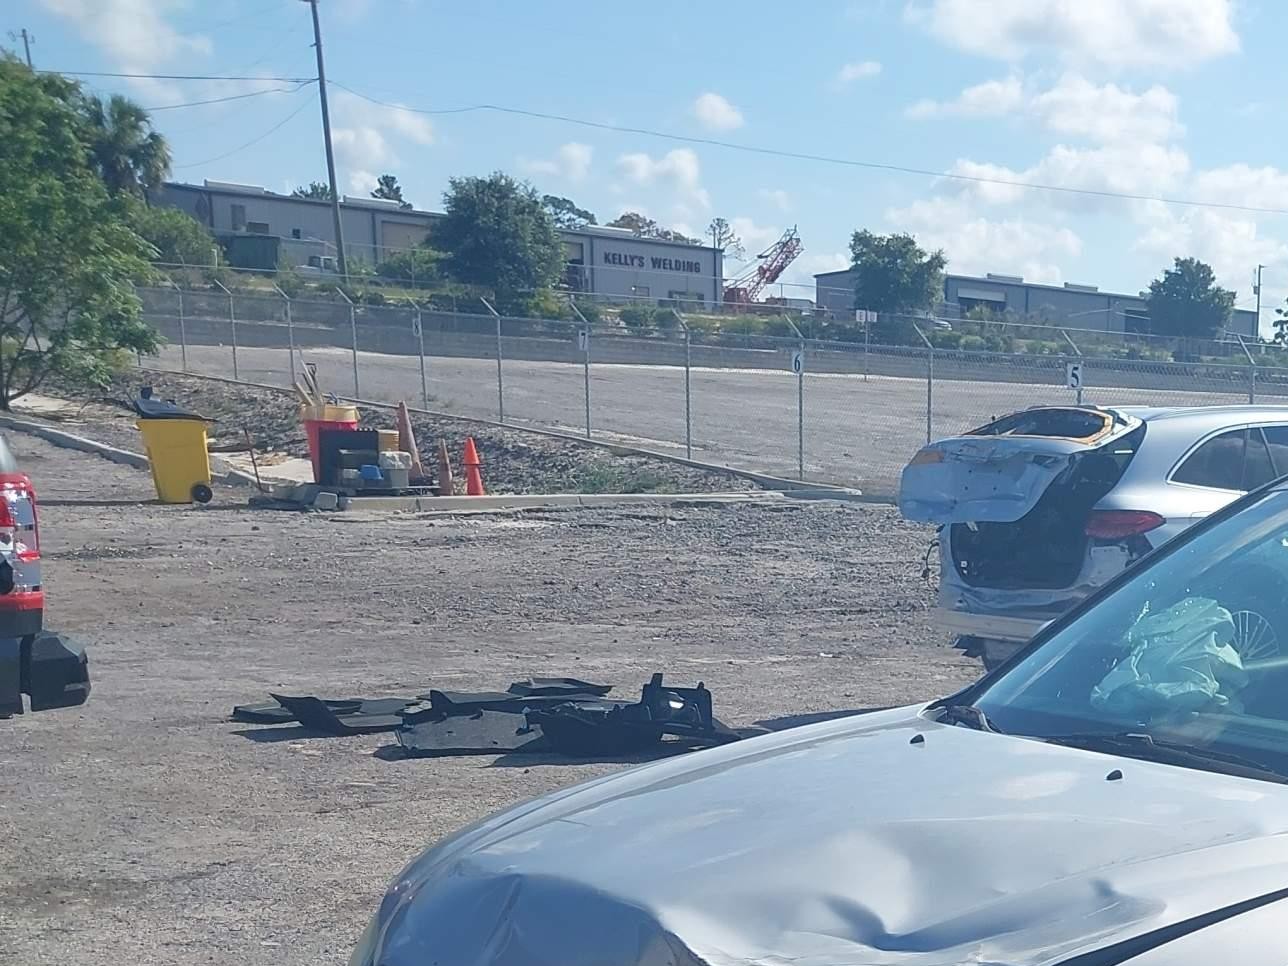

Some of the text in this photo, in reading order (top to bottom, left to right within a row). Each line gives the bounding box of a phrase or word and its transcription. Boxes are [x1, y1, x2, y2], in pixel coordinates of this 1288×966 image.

[603, 251, 701, 273] KELLY'S WELDING
[580, 331, 586, 349] 7
[794, 352, 801, 373] 6
[1070, 366, 1079, 388] 5
